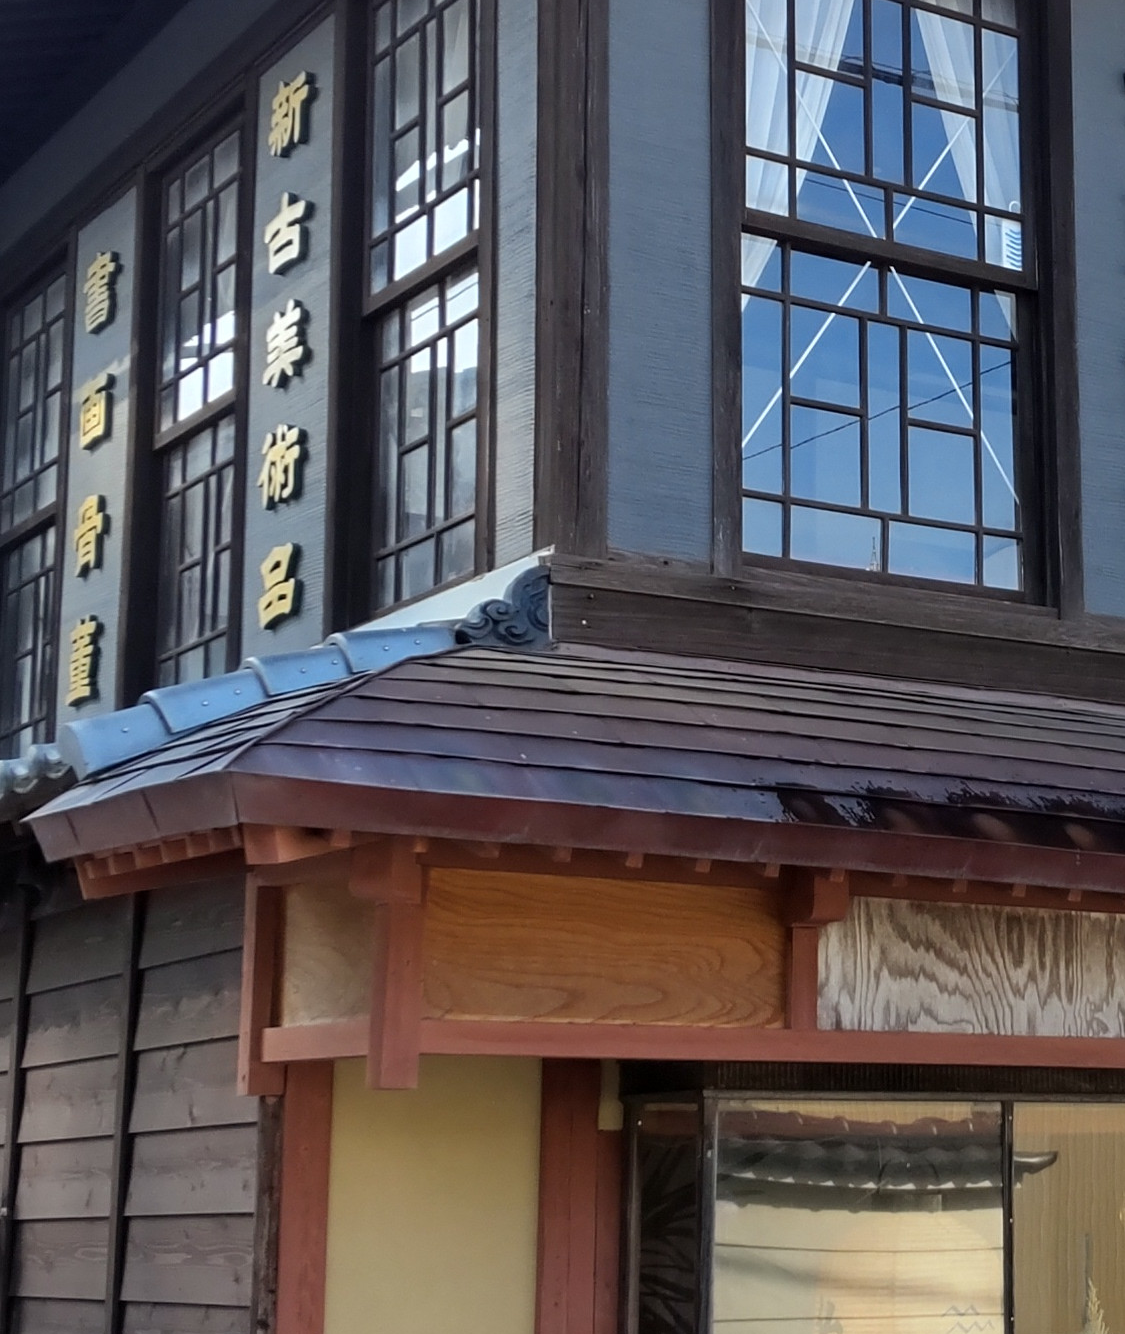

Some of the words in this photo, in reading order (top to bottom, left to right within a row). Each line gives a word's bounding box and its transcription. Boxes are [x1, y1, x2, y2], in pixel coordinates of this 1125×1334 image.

[65, 250, 122, 707] 書画骨董
[257, 69, 314, 631] 新古美術品
